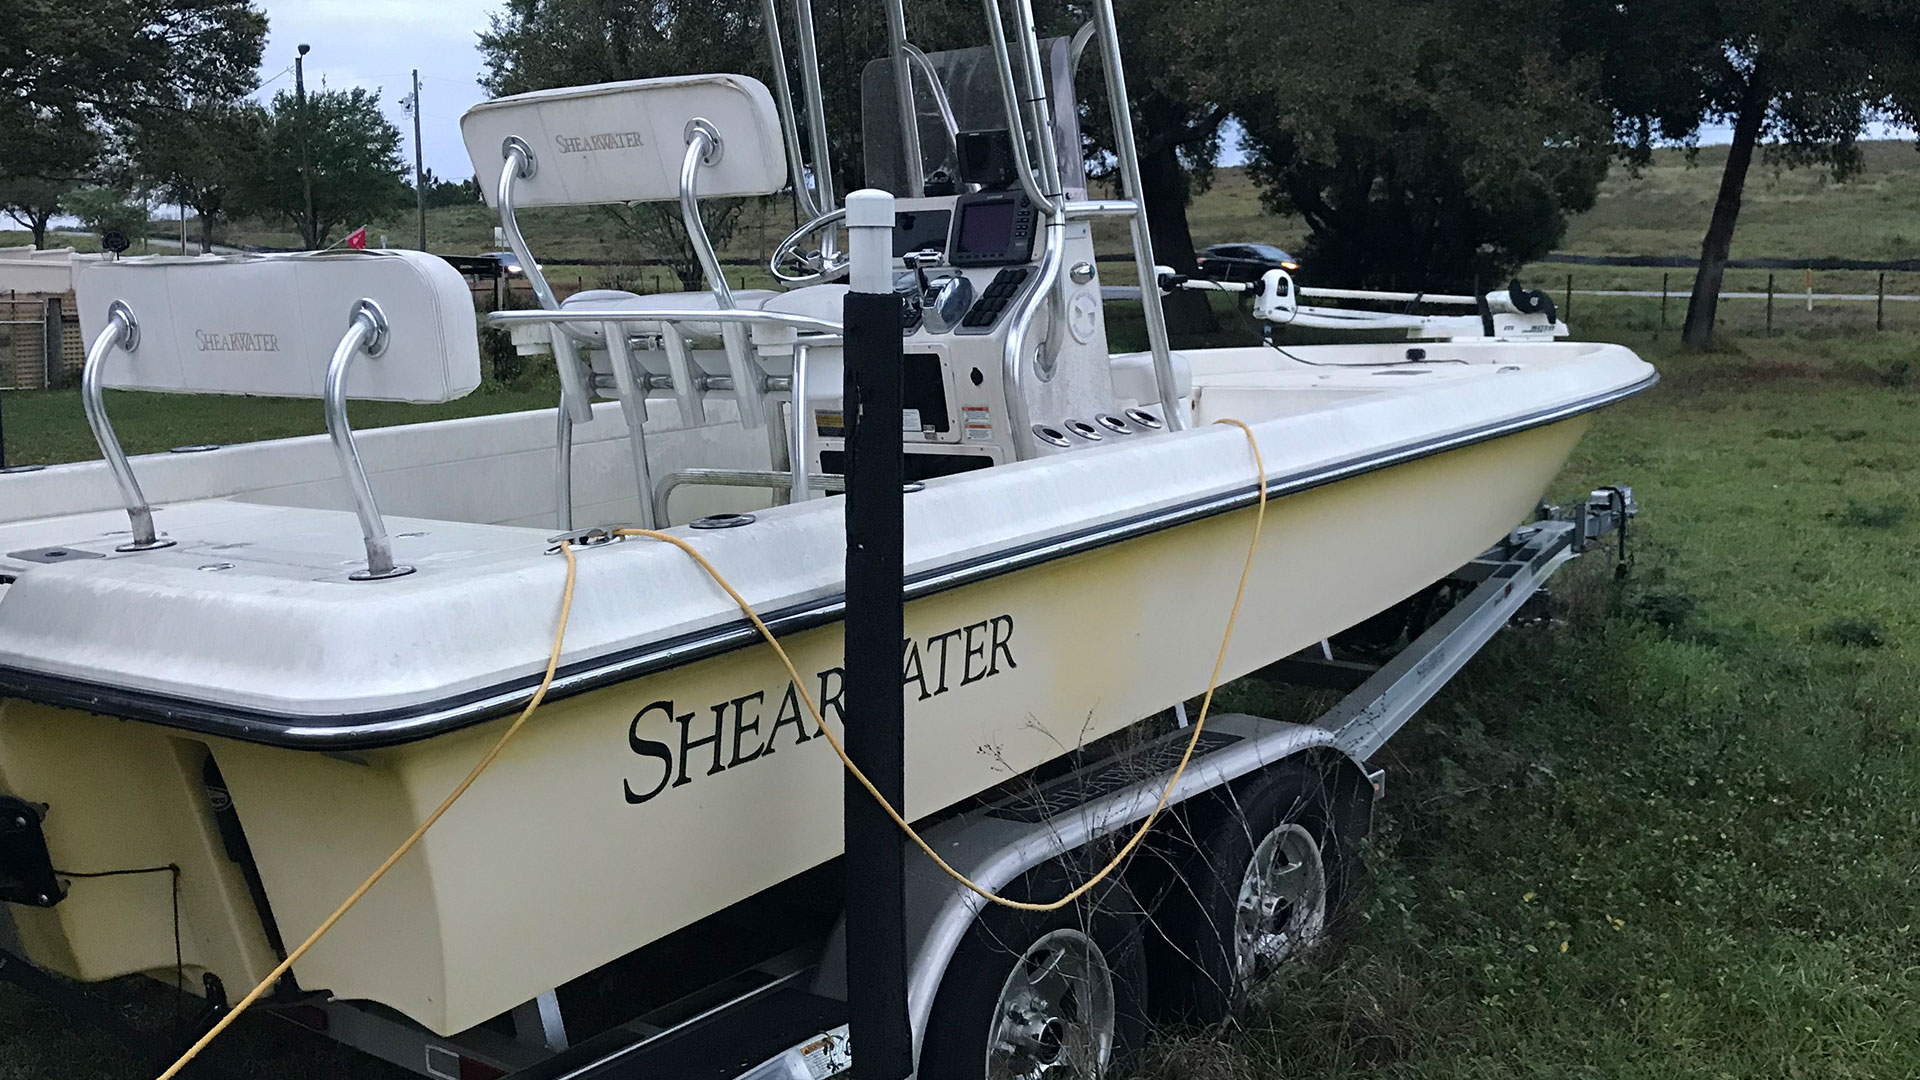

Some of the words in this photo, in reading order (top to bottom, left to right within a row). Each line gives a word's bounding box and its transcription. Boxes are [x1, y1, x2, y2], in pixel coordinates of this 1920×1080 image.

[556, 132, 644, 153] SHEARWATER
[195, 329, 280, 352] SHEARWATER
[624, 614, 1017, 805] SHEARATER
